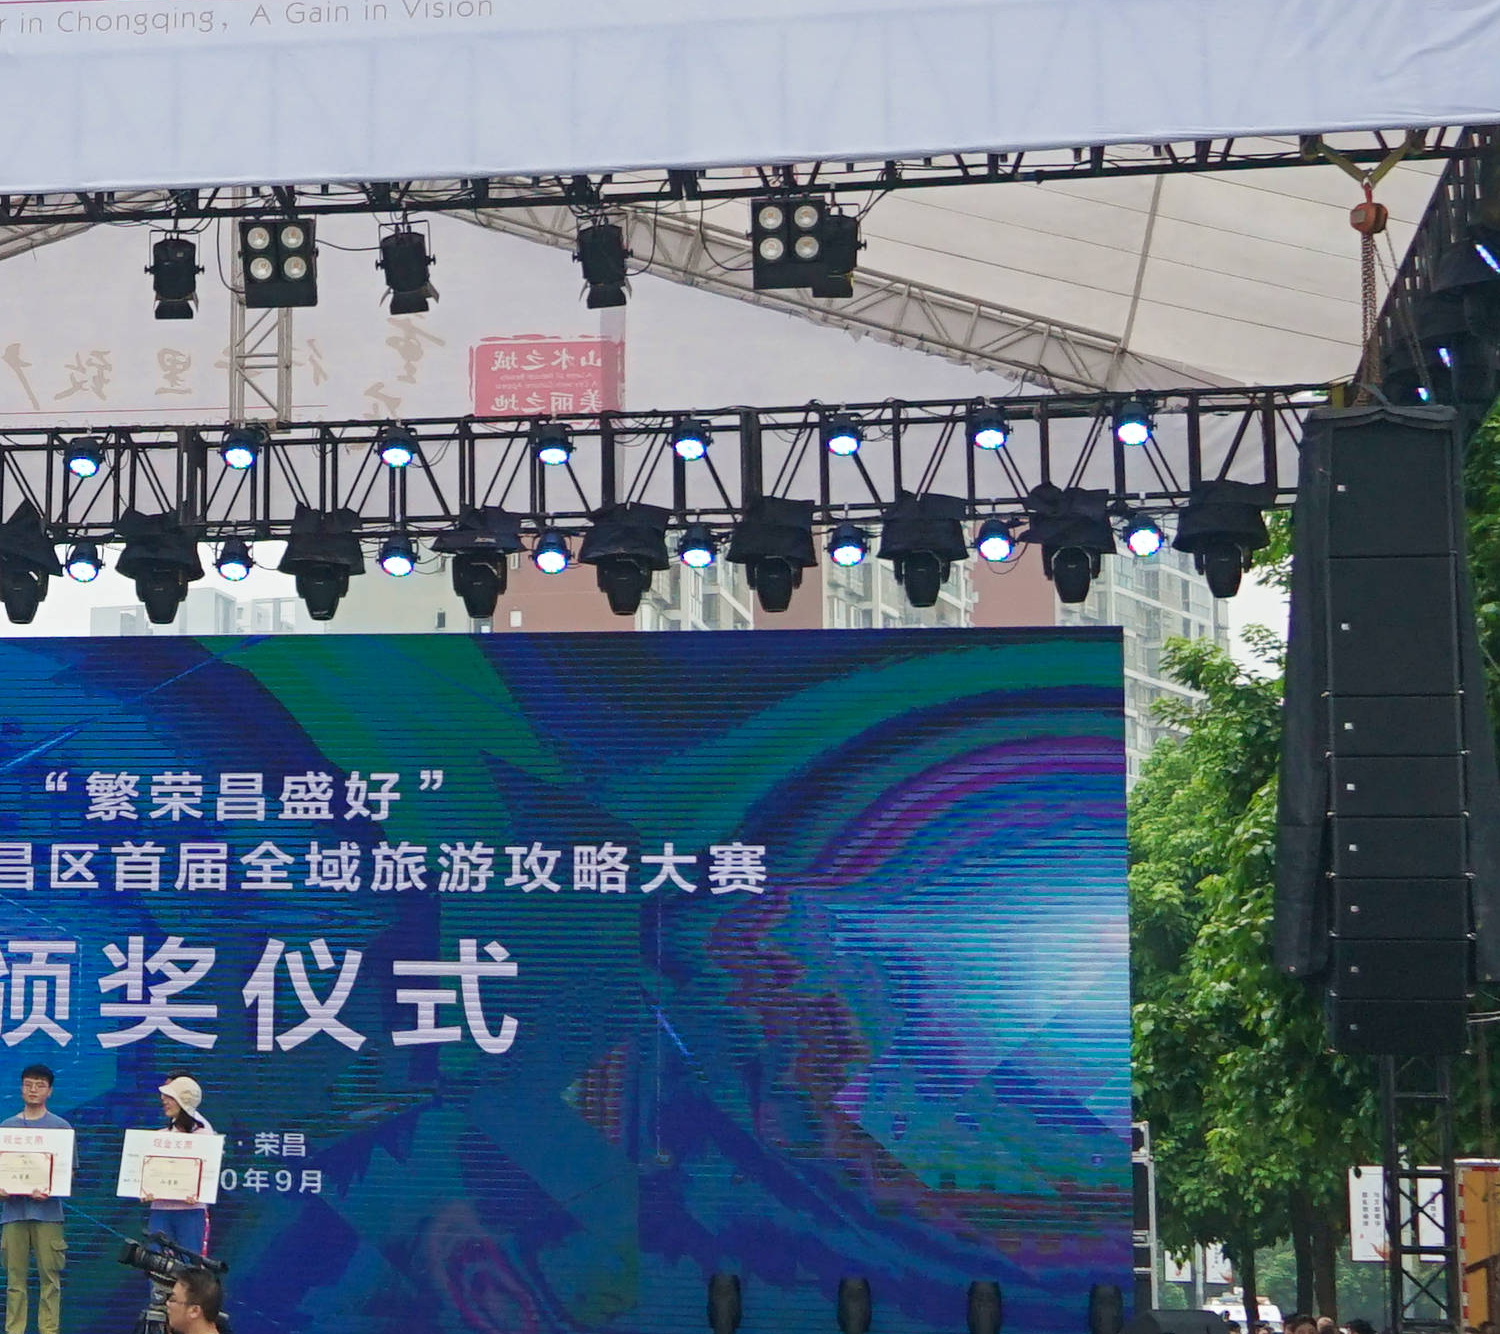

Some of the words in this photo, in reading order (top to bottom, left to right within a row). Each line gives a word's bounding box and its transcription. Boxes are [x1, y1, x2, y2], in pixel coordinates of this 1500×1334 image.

[18, 9, 42, 34] in
[56, 6, 230, 37] Chongqing,
[248, 1, 273, 26] A
